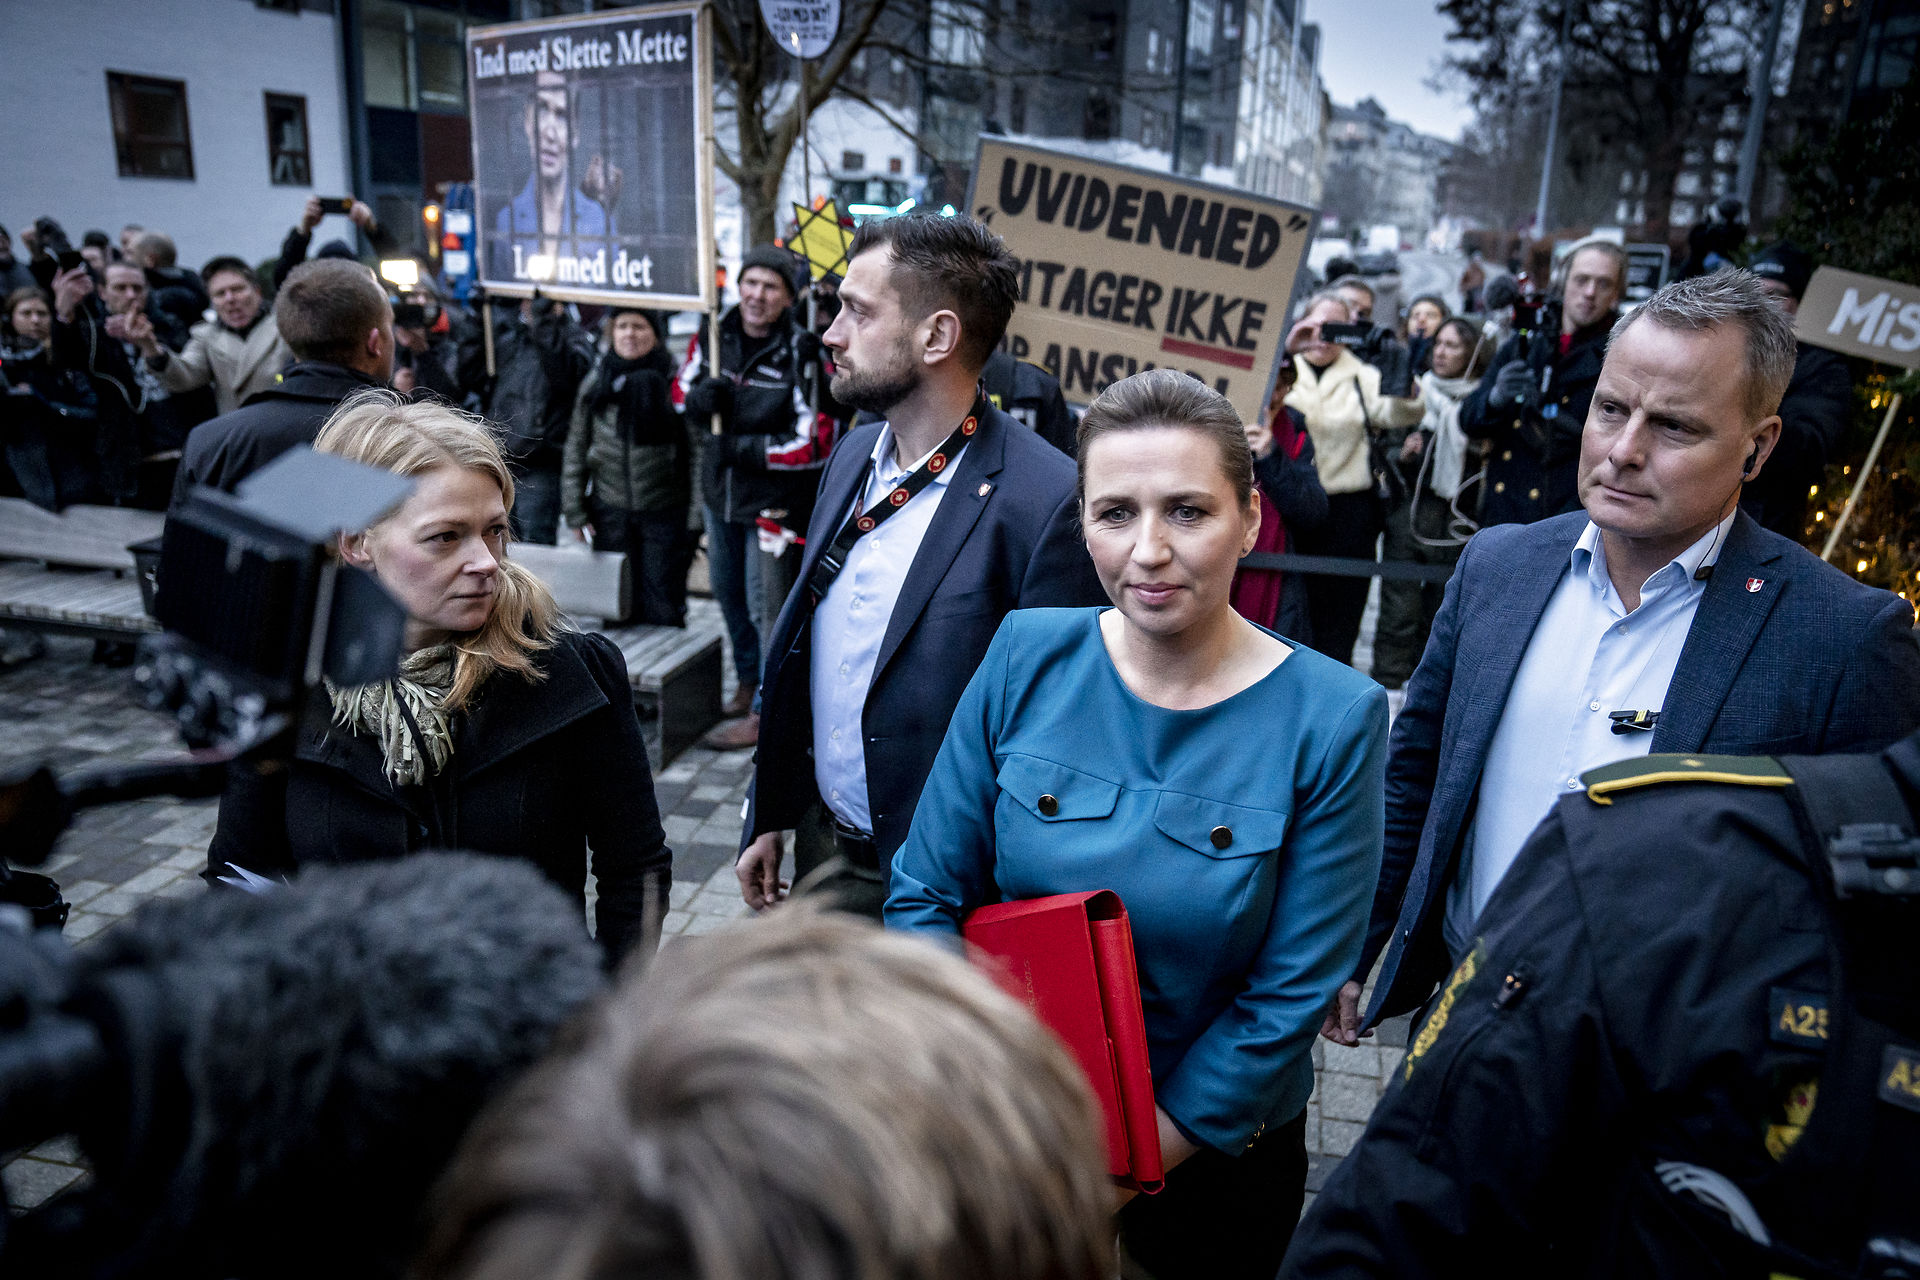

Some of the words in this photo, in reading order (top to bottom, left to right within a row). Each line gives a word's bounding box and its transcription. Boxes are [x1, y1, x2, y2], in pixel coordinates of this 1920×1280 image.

[475, 45, 505, 79] Ind
[508, 40, 548, 74] med
[552, 35, 612, 71] Slette
[616, 28, 687, 66] Mette
[558, 248, 607, 284] med
[612, 250, 653, 287] det
[1008, 256, 1163, 330] ITAGER
[1164, 286, 1267, 350] IKKE
